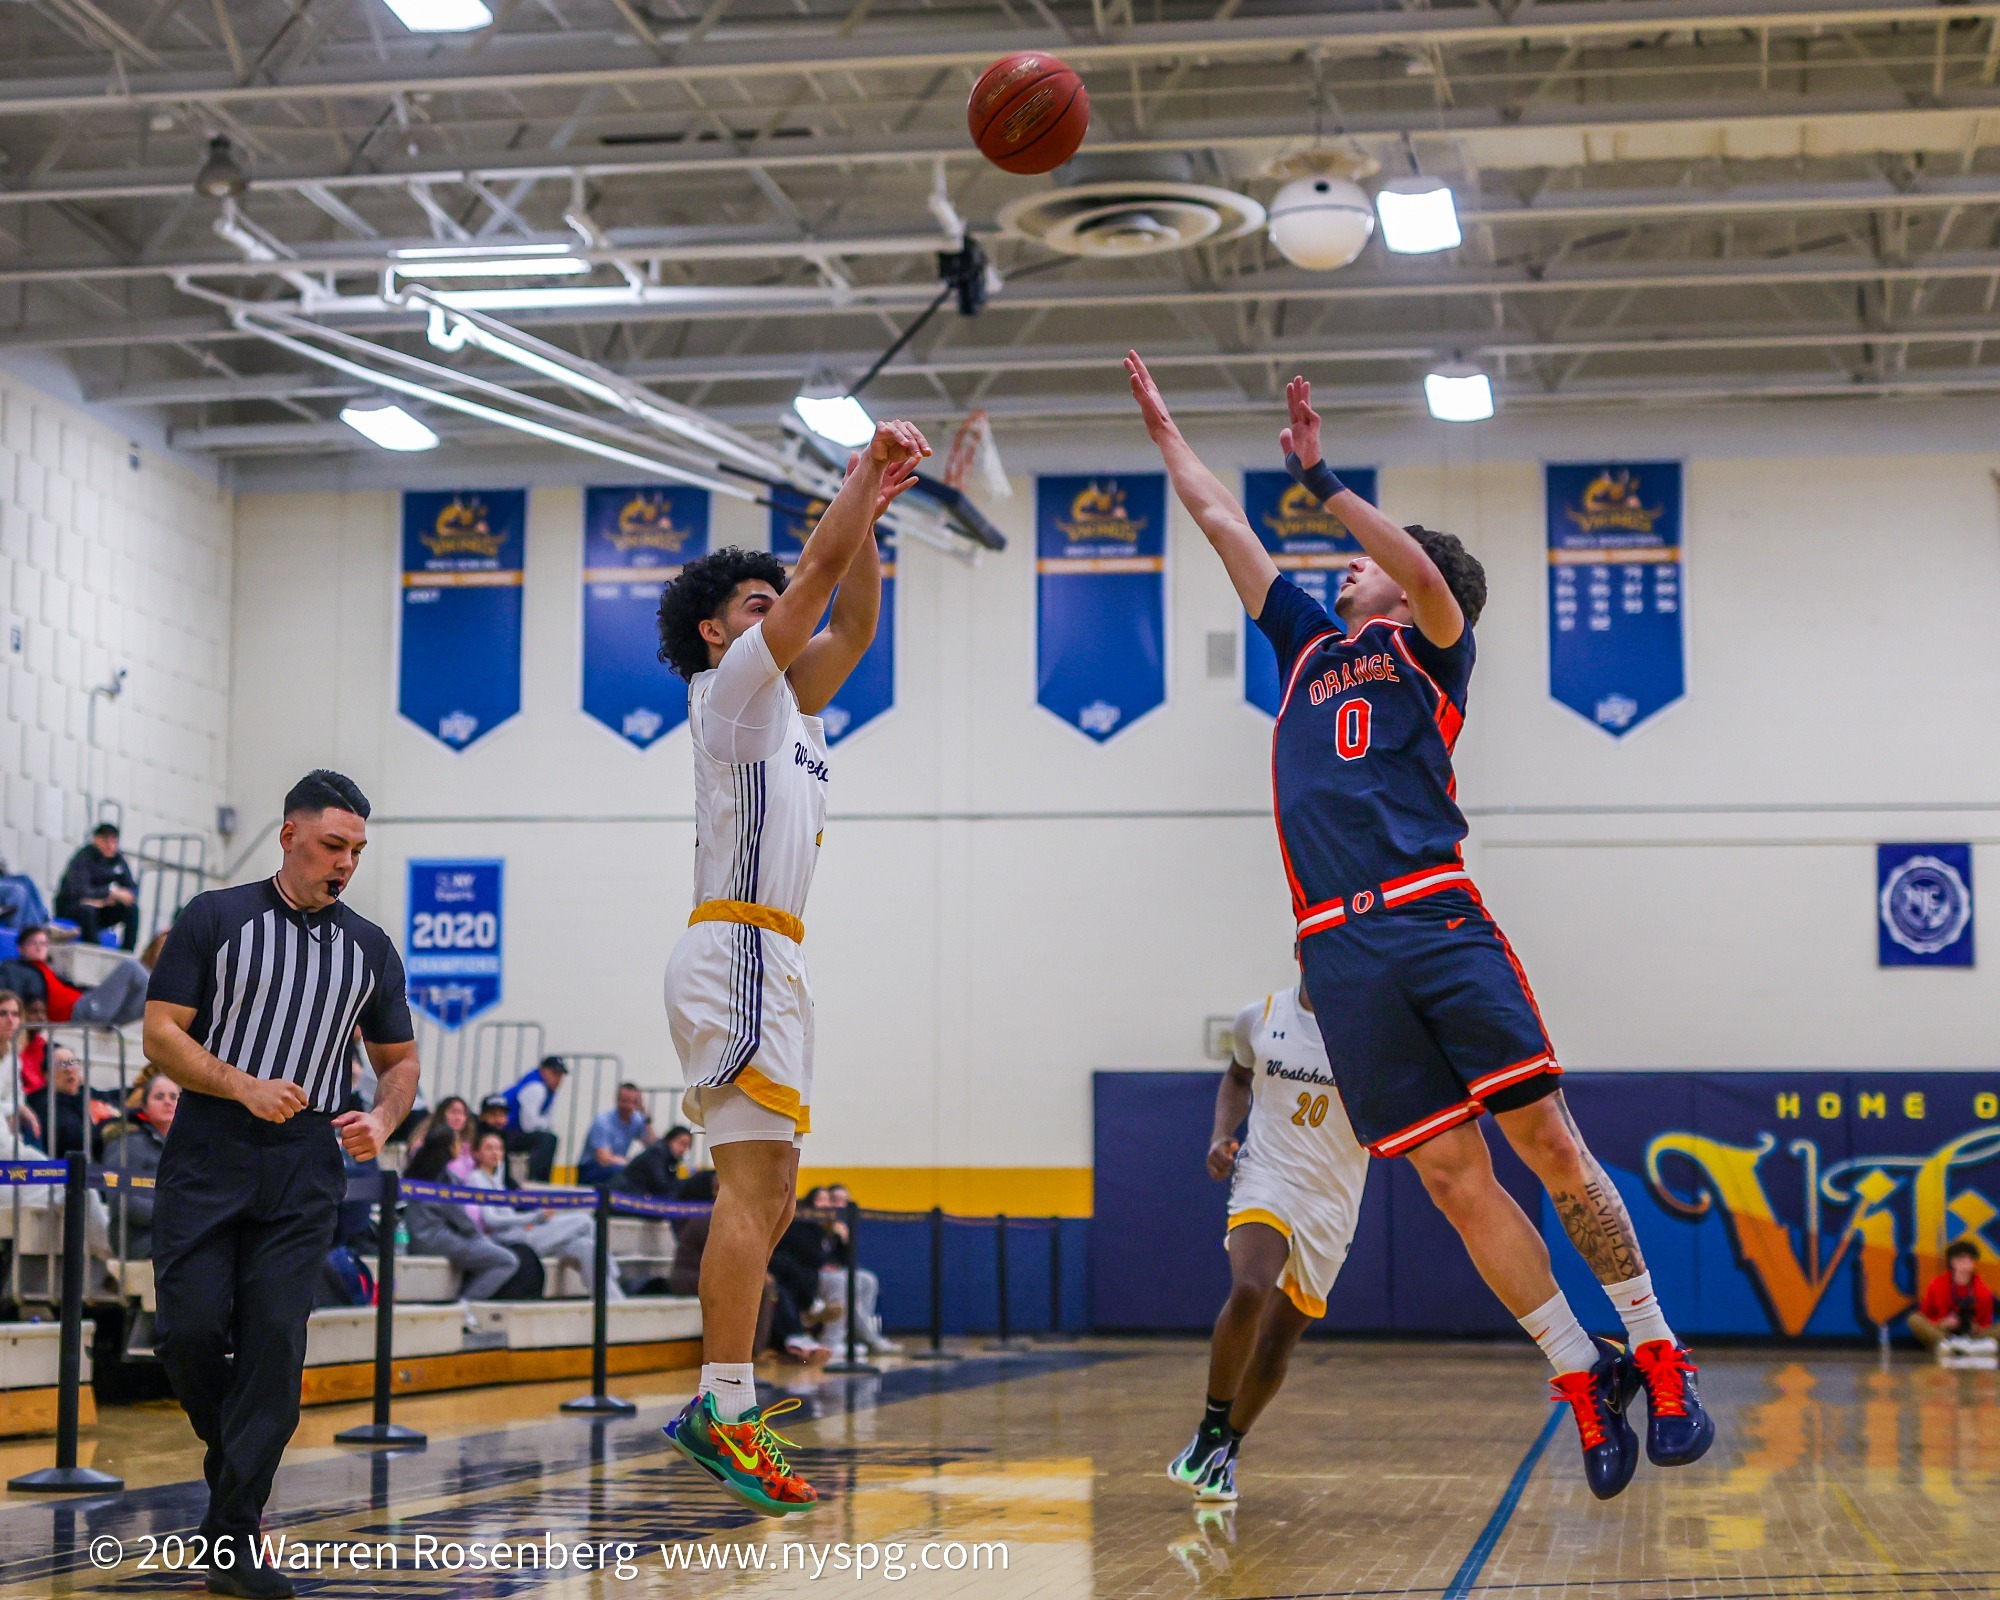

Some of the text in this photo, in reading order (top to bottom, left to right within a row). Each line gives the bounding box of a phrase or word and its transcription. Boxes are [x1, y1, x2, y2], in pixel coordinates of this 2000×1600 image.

[1309, 653, 1400, 706] ORANGE
[1335, 697, 1373, 761] 0
[412, 911, 498, 949] 2020
[1291, 1092, 1330, 1128] 20
[1776, 1092, 1926, 1119] HOME
